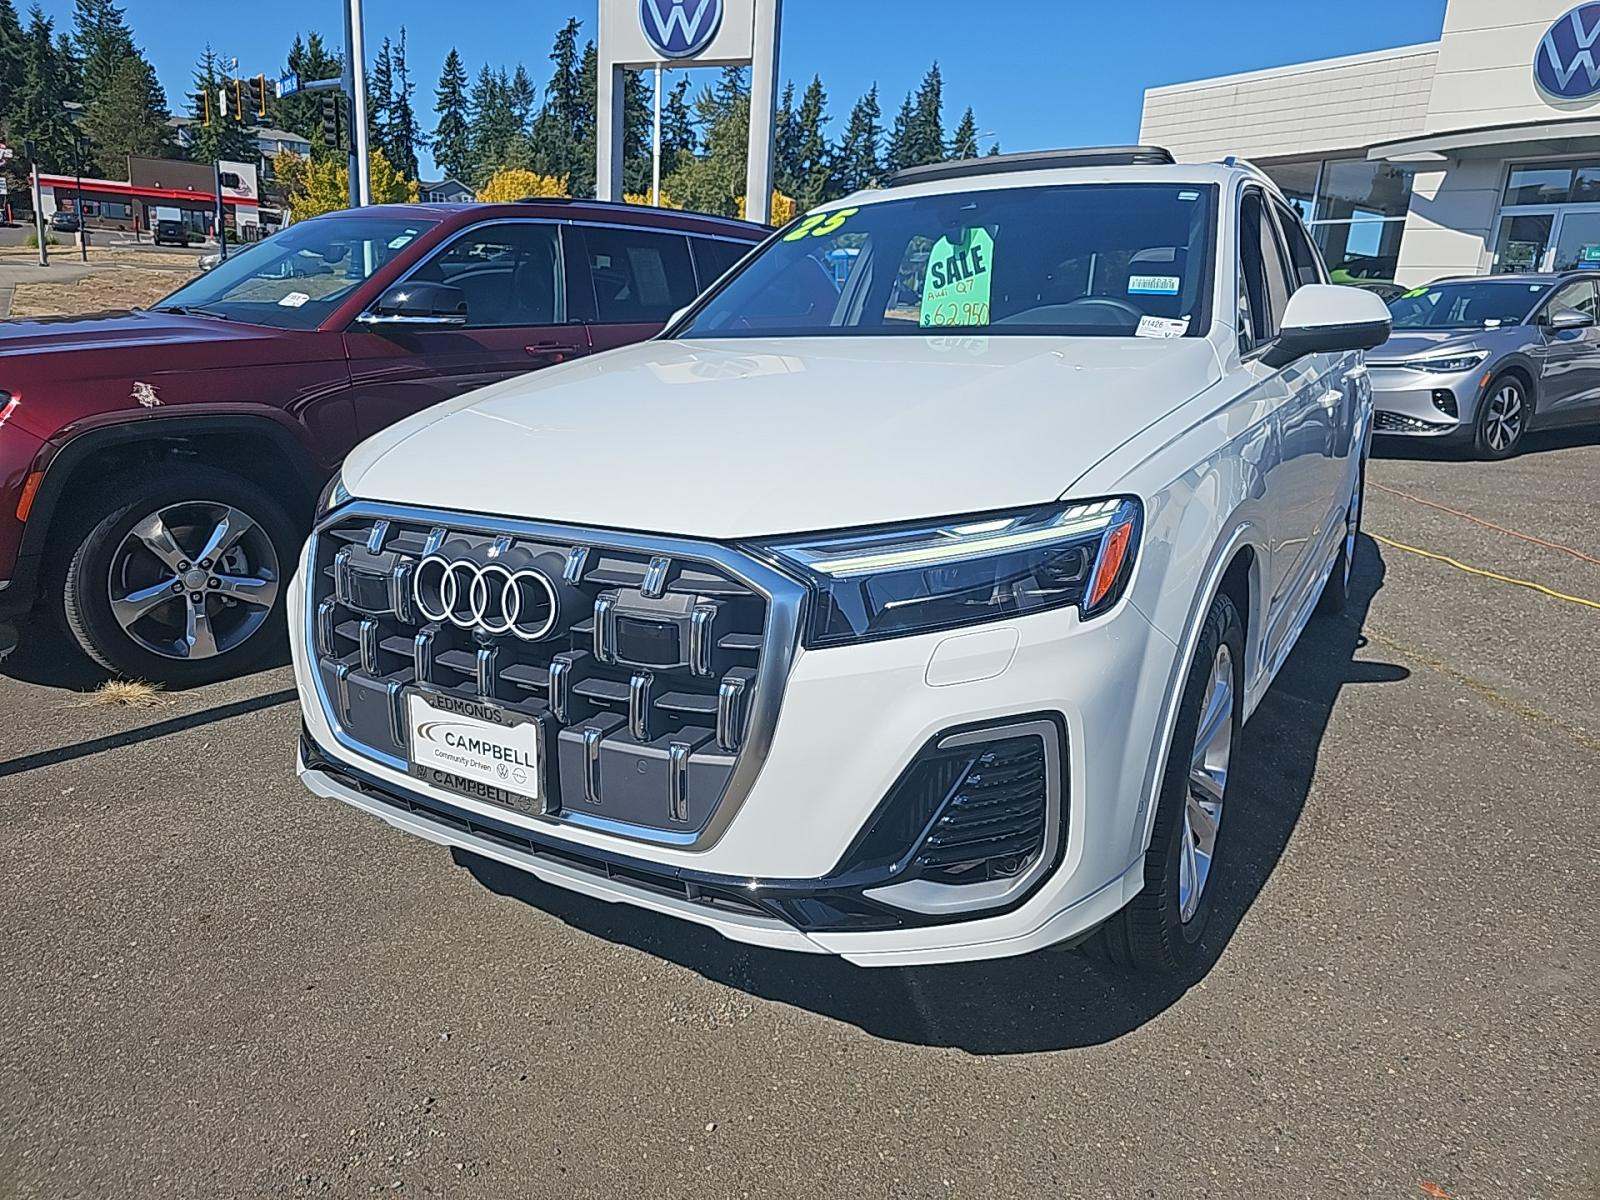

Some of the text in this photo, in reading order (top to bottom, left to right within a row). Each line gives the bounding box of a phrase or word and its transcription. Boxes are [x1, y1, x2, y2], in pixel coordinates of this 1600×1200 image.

[783, 208, 859, 242] 25
[931, 245, 986, 290] SALE
[956, 279, 974, 294] Q7
[436, 696, 503, 723] EDMONDS
[434, 749, 492, 773] Community Driven
[445, 732, 535, 769] CAMPBELL
[433, 770, 515, 806] CAMPBELL
